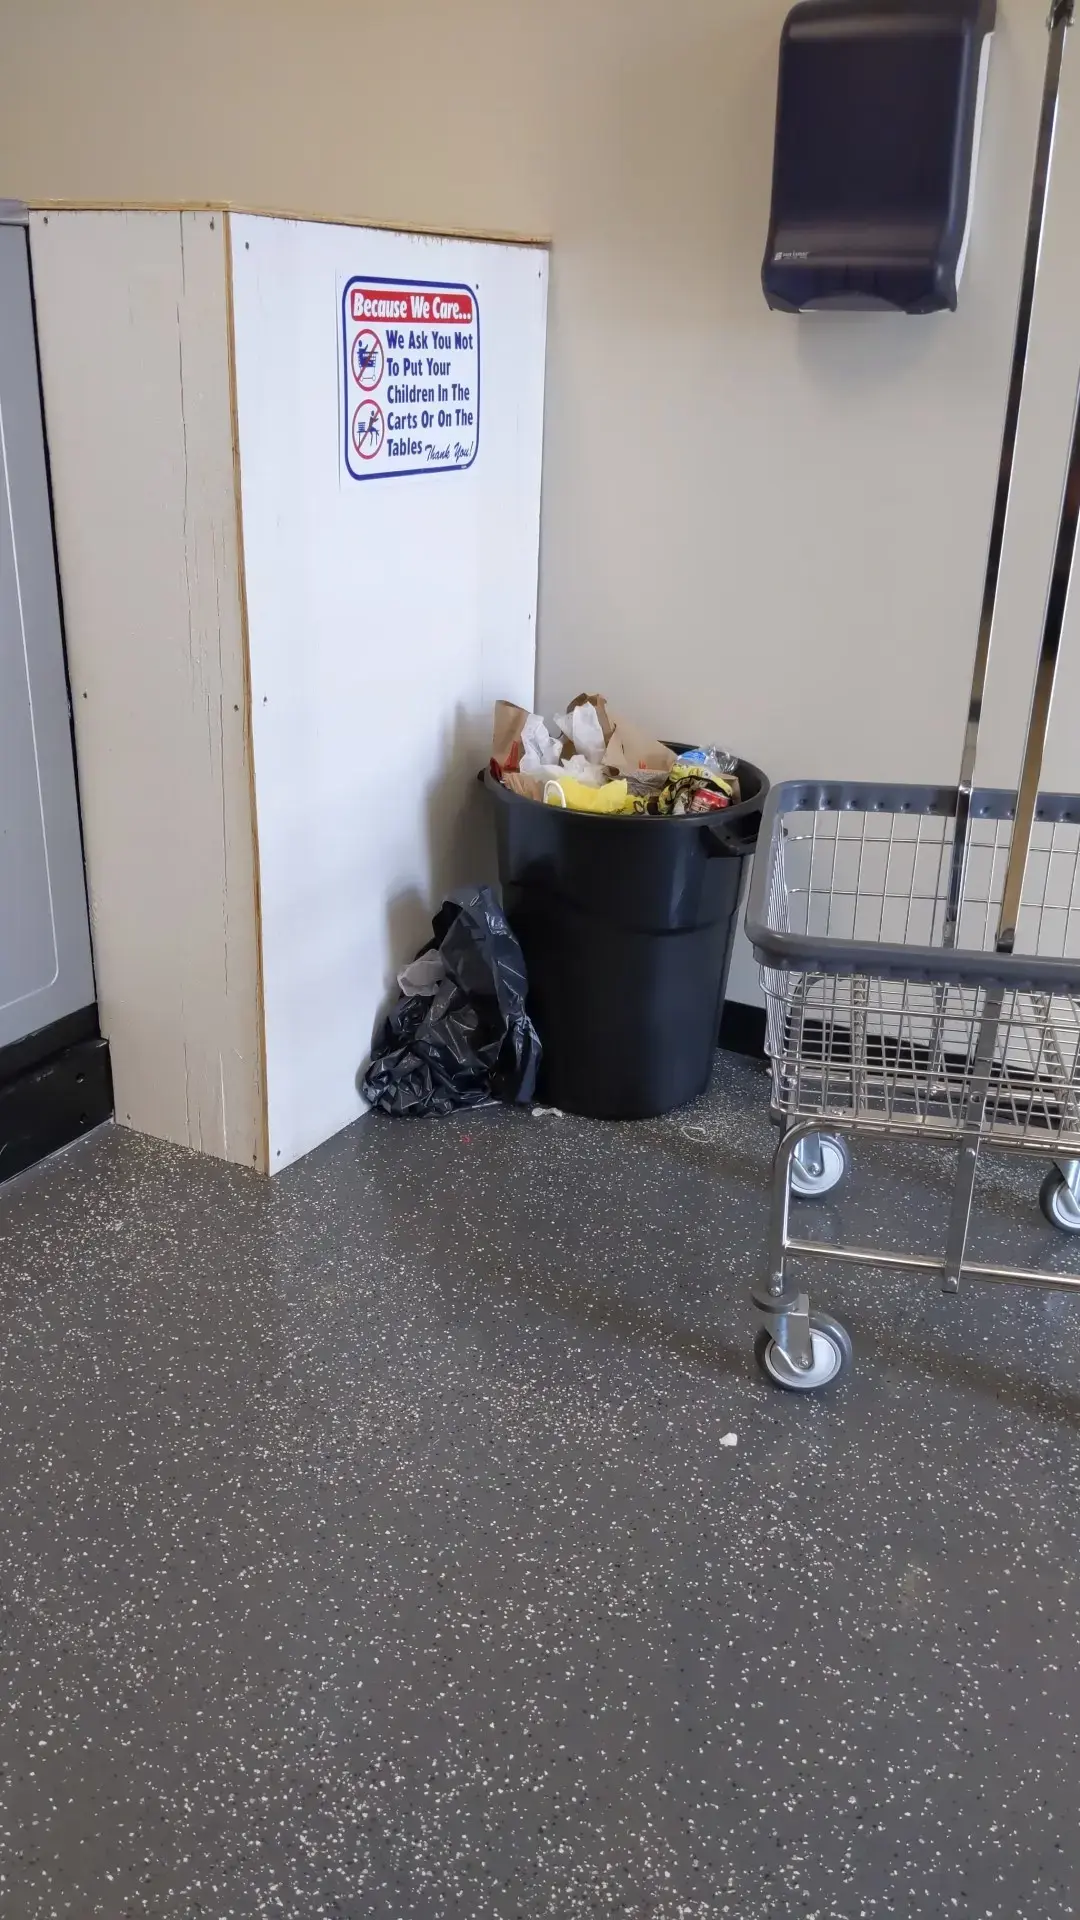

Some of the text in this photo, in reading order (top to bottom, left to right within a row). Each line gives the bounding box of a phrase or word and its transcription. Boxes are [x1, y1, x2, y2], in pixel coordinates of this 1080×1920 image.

[353, 292, 472, 320] Because We Care...
[386, 329, 474, 350] We Ask You Not
[386, 358, 451, 376] To Put Your
[387, 383, 470, 404] Children In The
[387, 408, 474, 430] Carts Or On The
[386, 438, 423, 457] Tables
[424, 441, 474, 463] Thank You!
